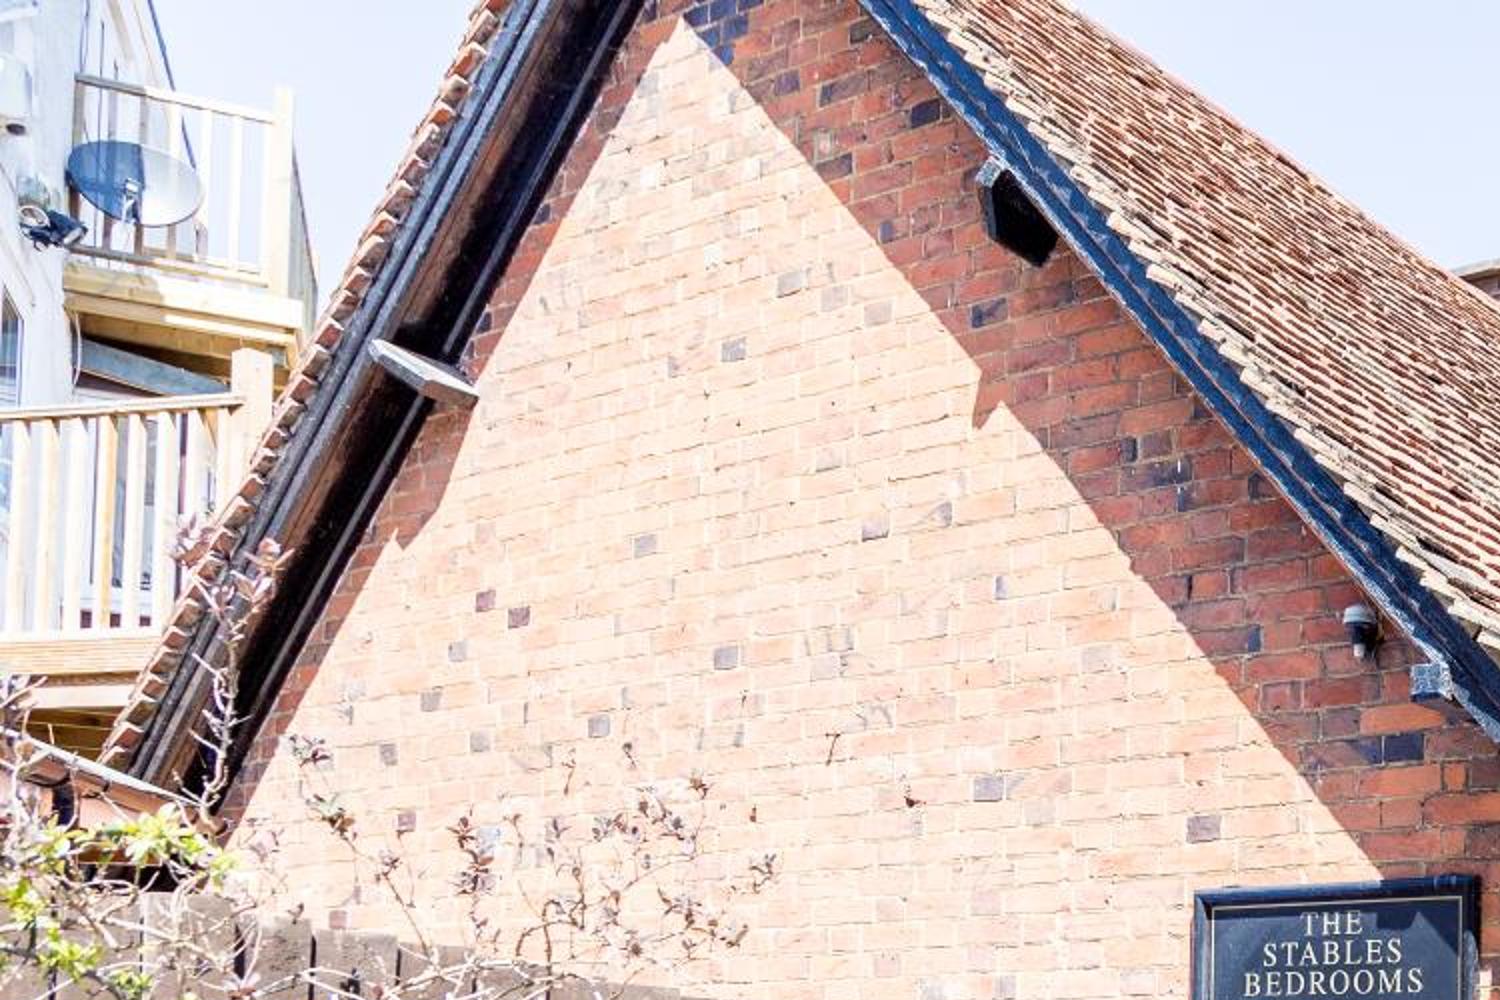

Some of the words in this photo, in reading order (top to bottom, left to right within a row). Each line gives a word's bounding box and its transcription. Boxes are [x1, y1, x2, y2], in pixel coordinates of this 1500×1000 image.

[1301, 910, 1363, 936] THE
[1263, 938, 1402, 967] STABLES
[1243, 967, 1424, 997] BEDROOMS
